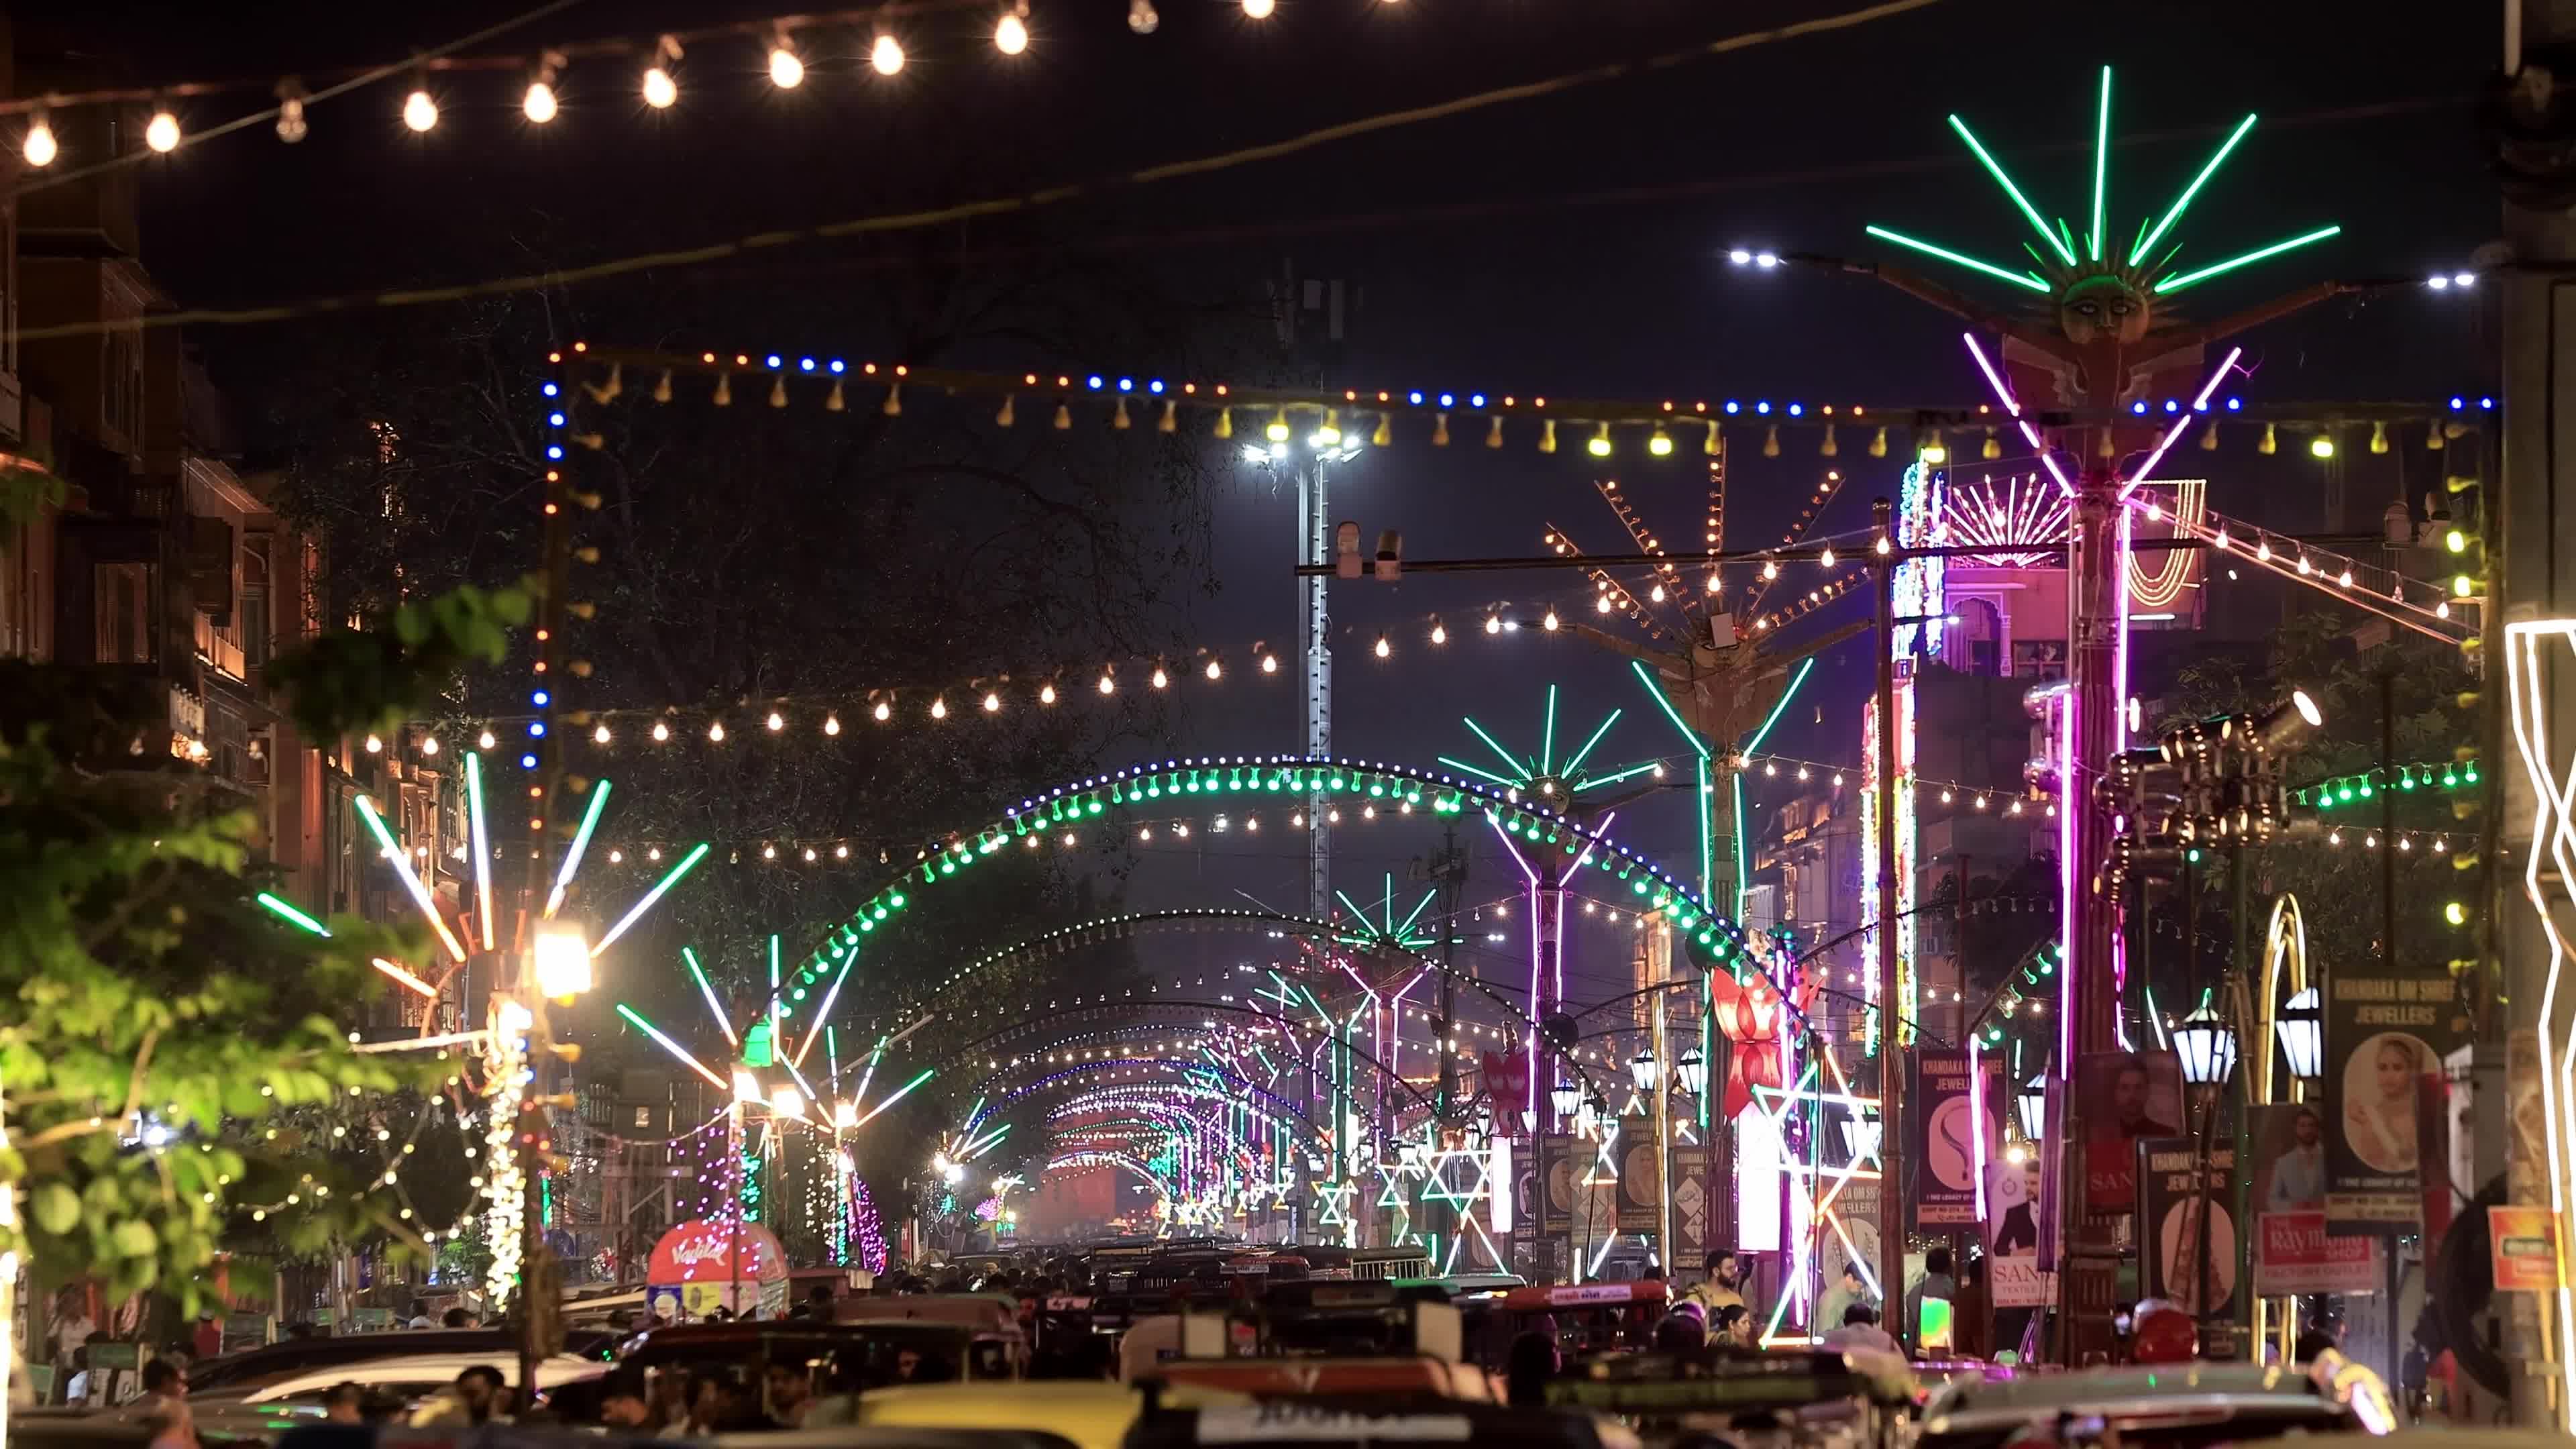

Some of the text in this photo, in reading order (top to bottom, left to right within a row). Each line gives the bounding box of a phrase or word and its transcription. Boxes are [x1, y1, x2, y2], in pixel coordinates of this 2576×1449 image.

[2353, 1006, 2437, 1026] JEWELLERS
[1922, 1060, 1964, 1075] KHANDAKA
[1834, 1201, 1877, 1214] EWELLERS
